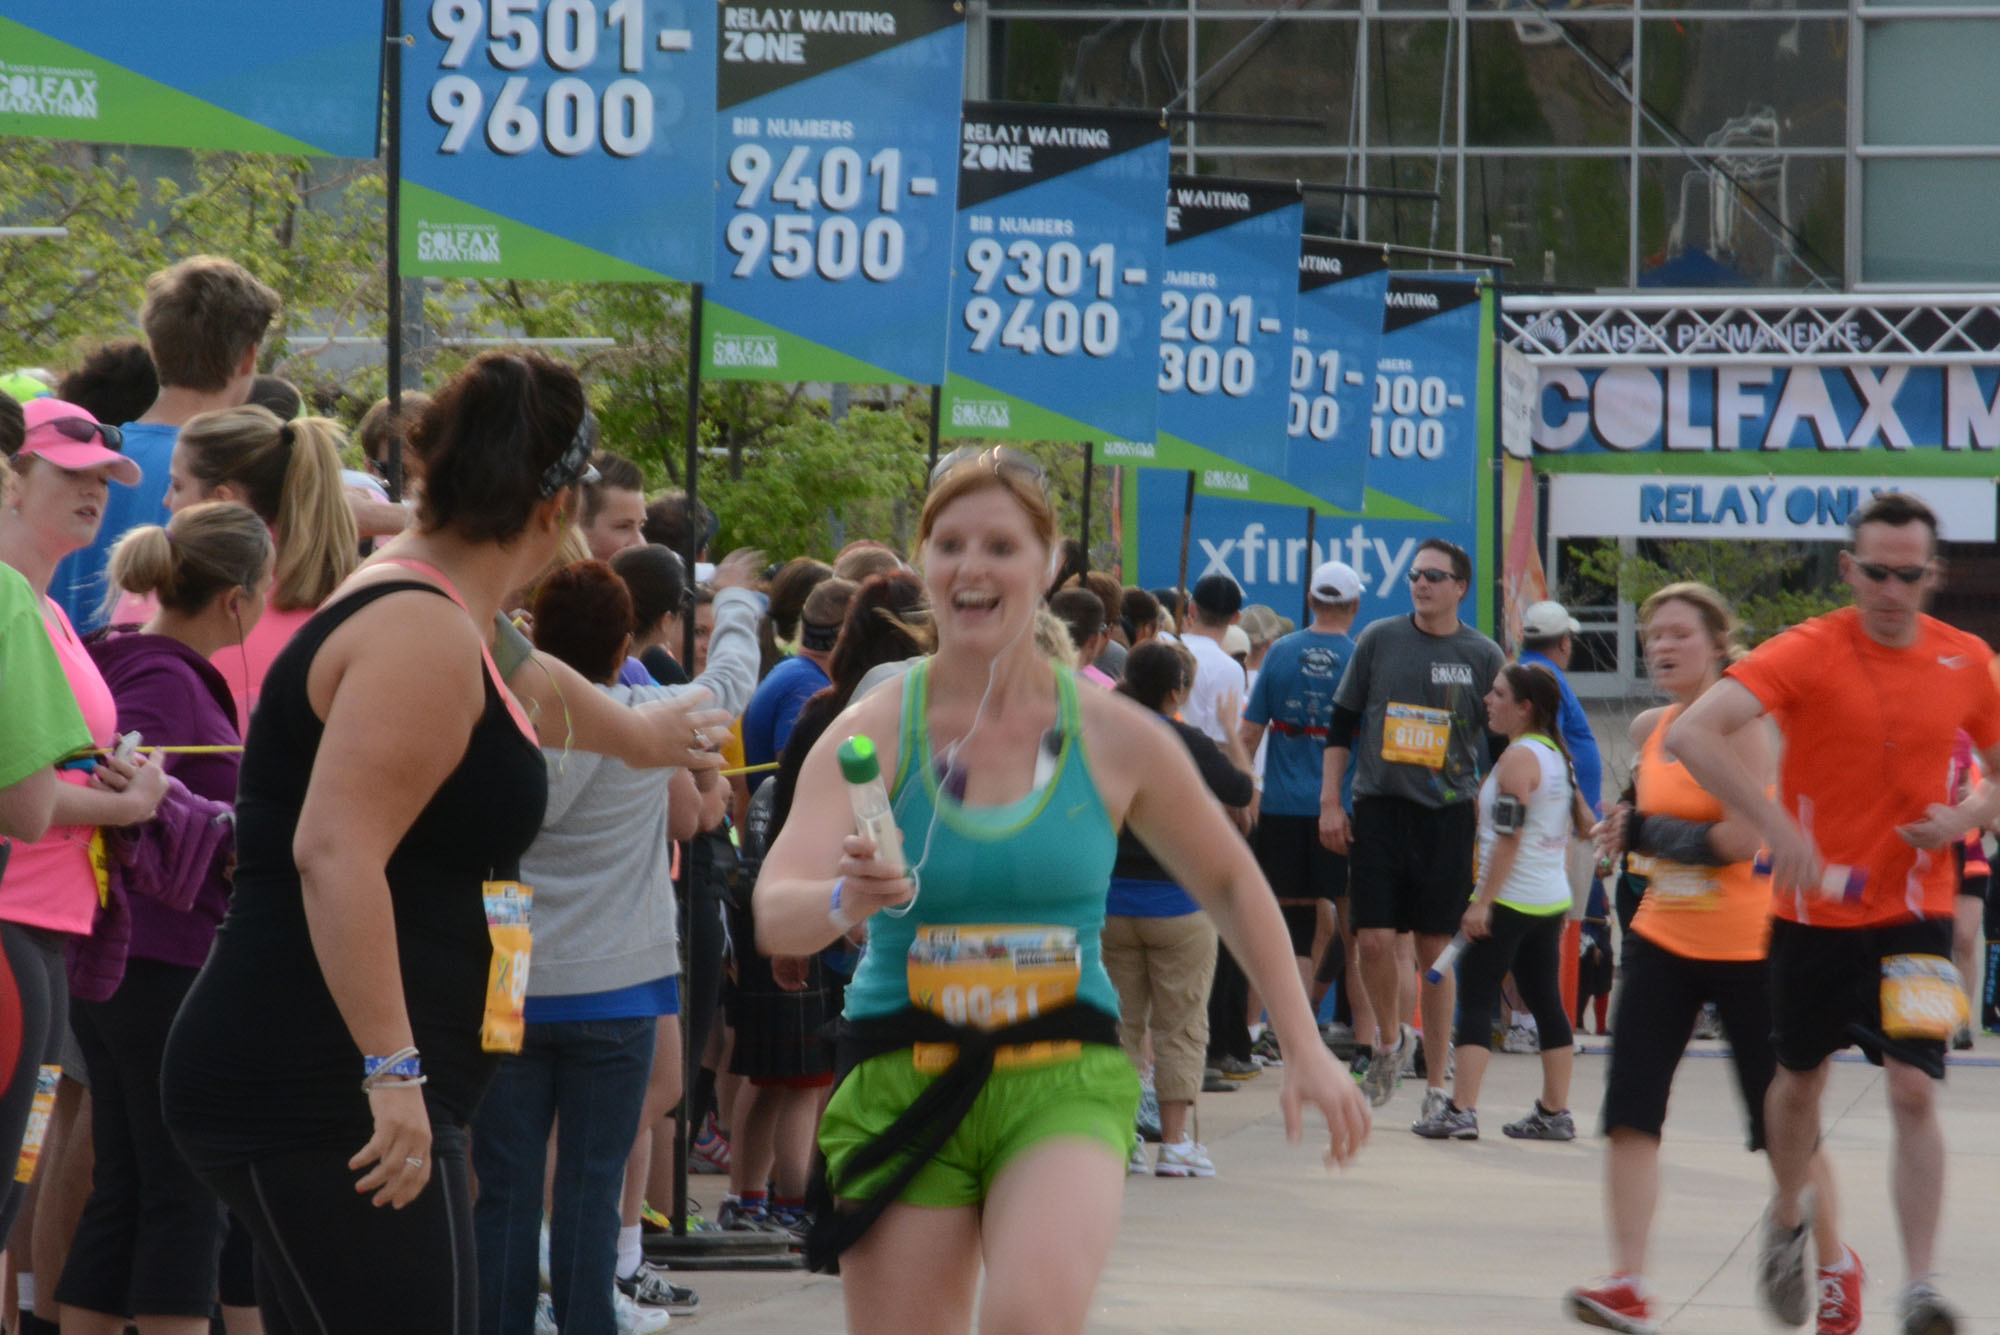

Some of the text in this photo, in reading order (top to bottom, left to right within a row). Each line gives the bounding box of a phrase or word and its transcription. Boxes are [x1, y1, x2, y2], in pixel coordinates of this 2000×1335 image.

[428, 0, 692, 73] 9501-
[724, 6, 897, 35] RELAY WAITING
[723, 31, 807, 64] ZONE
[428, 74, 654, 157] 9600
[732, 116, 856, 139] BIB NUMBERS
[963, 122, 1111, 149] RELAY WAITING
[961, 143, 1034, 172] ZONE
[727, 143, 938, 212] 9401-
[1177, 187, 1250, 211] WAITING
[418, 230, 501, 249] COLFAX
[969, 215, 1076, 237] BIB NUMBERS
[725, 212, 905, 282] 9500
[965, 237, 1148, 298] 9301-
[963, 296, 1120, 358] 9400
[1578, 323, 1669, 351] KAISER
[1532, 366, 1915, 451] COLFAX
[1640, 483, 1776, 524] RELAY
[1197, 522, 1416, 599] xfinity
